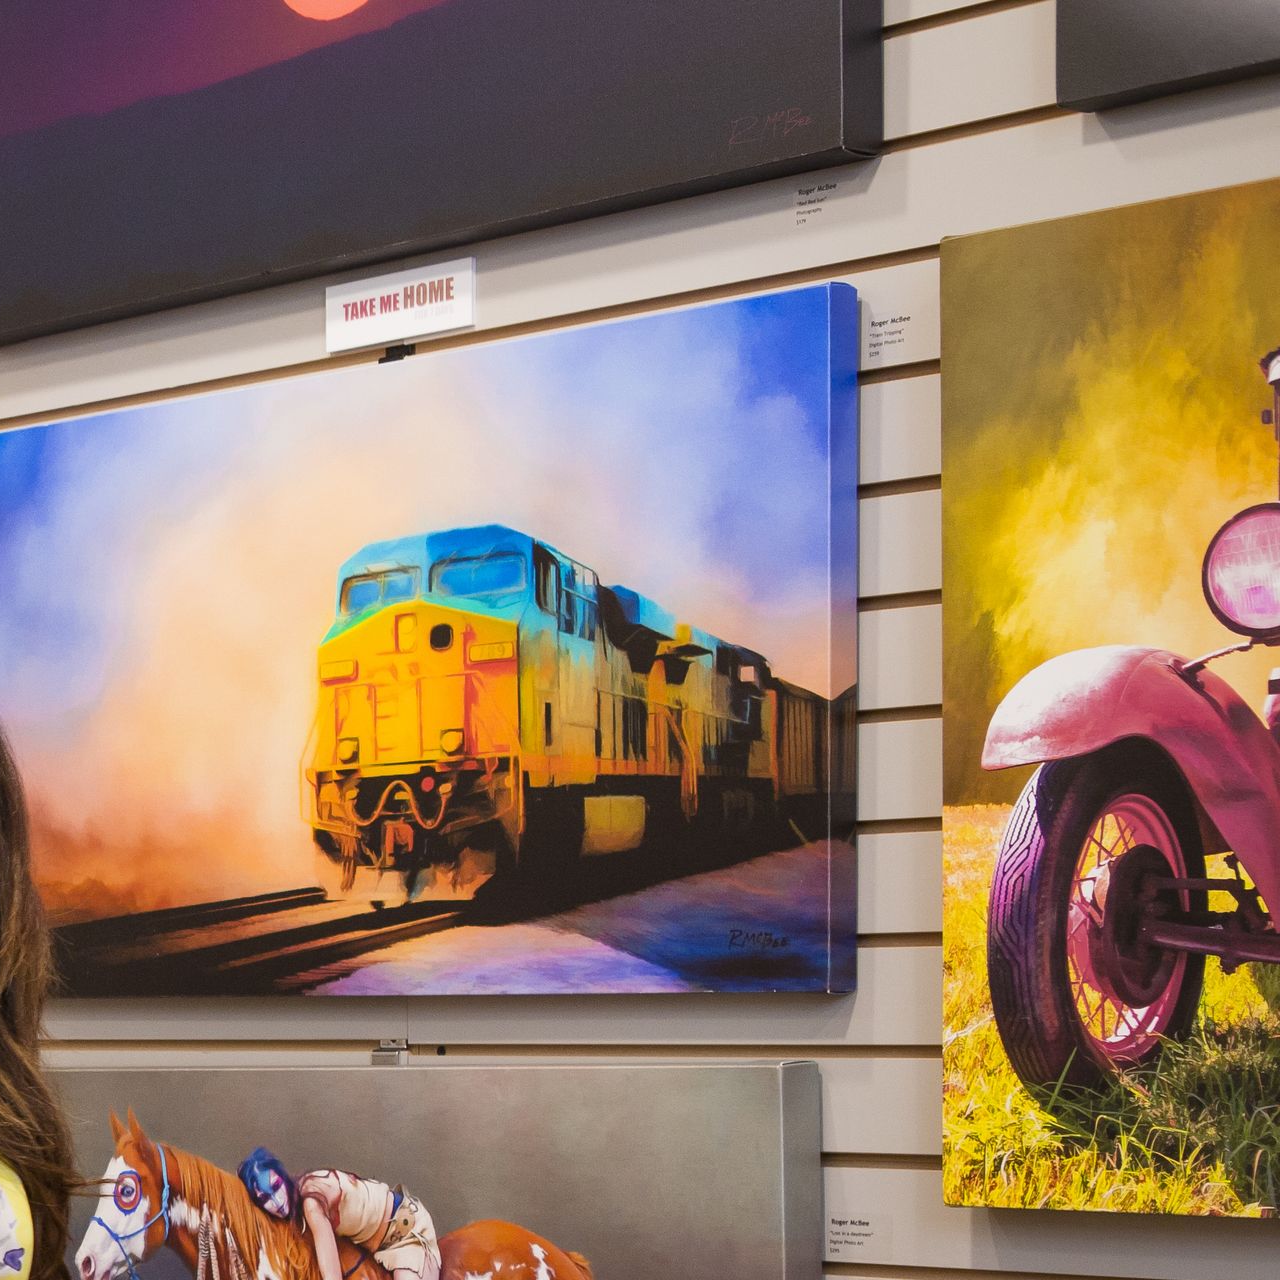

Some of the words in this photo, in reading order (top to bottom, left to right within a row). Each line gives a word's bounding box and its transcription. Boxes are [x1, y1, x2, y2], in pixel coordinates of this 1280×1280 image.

[798, 188, 816, 196] Roger
[817, 183, 838, 192] McBee
[343, 298, 376, 322] TAKE
[379, 292, 400, 315] ME
[403, 277, 455, 310] HOME
[871, 320, 889, 328] Roger
[890, 316, 911, 324] McBee
[831, 1218, 849, 1226] Roger
